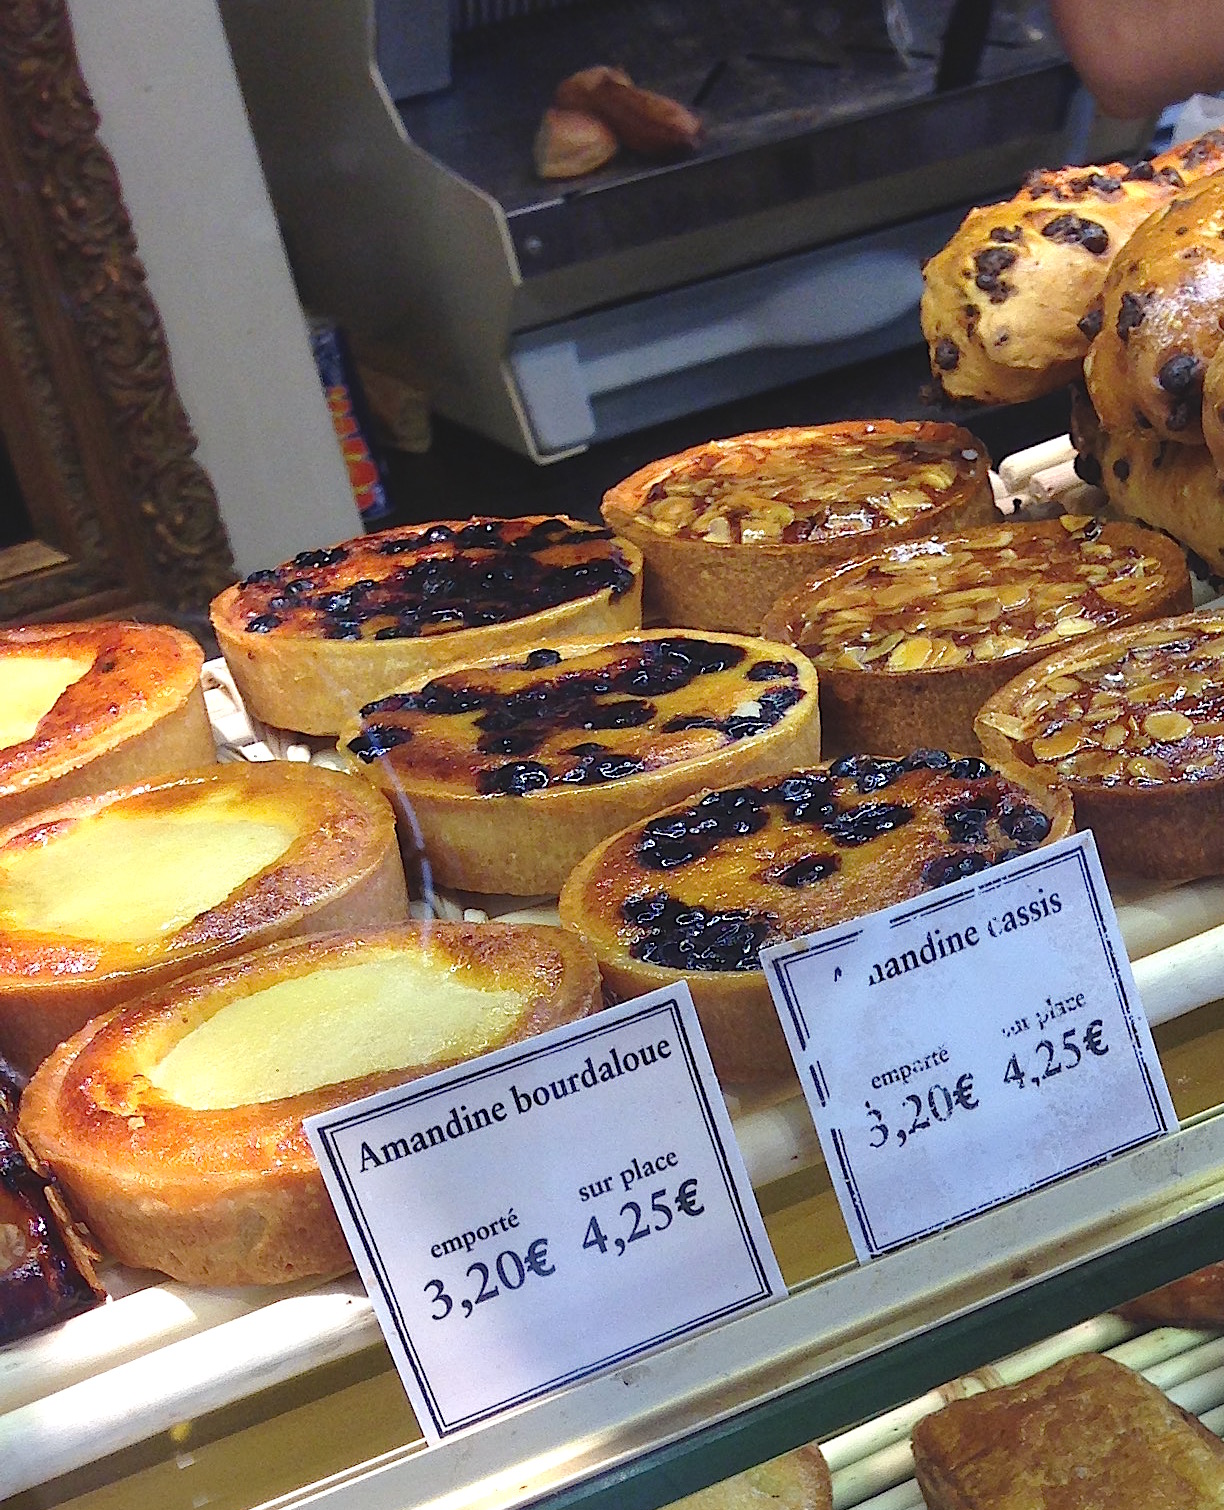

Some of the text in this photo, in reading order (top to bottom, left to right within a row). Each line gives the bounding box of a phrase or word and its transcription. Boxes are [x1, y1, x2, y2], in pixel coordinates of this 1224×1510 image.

[359, 1038, 672, 1173] Amandine bourdaloue
[865, 1019, 1109, 1148] 3,20€ 4,25€
[423, 1178, 705, 1321] 3,20€ 4,25€
[430, 1149, 679, 1260] emporté sur place
